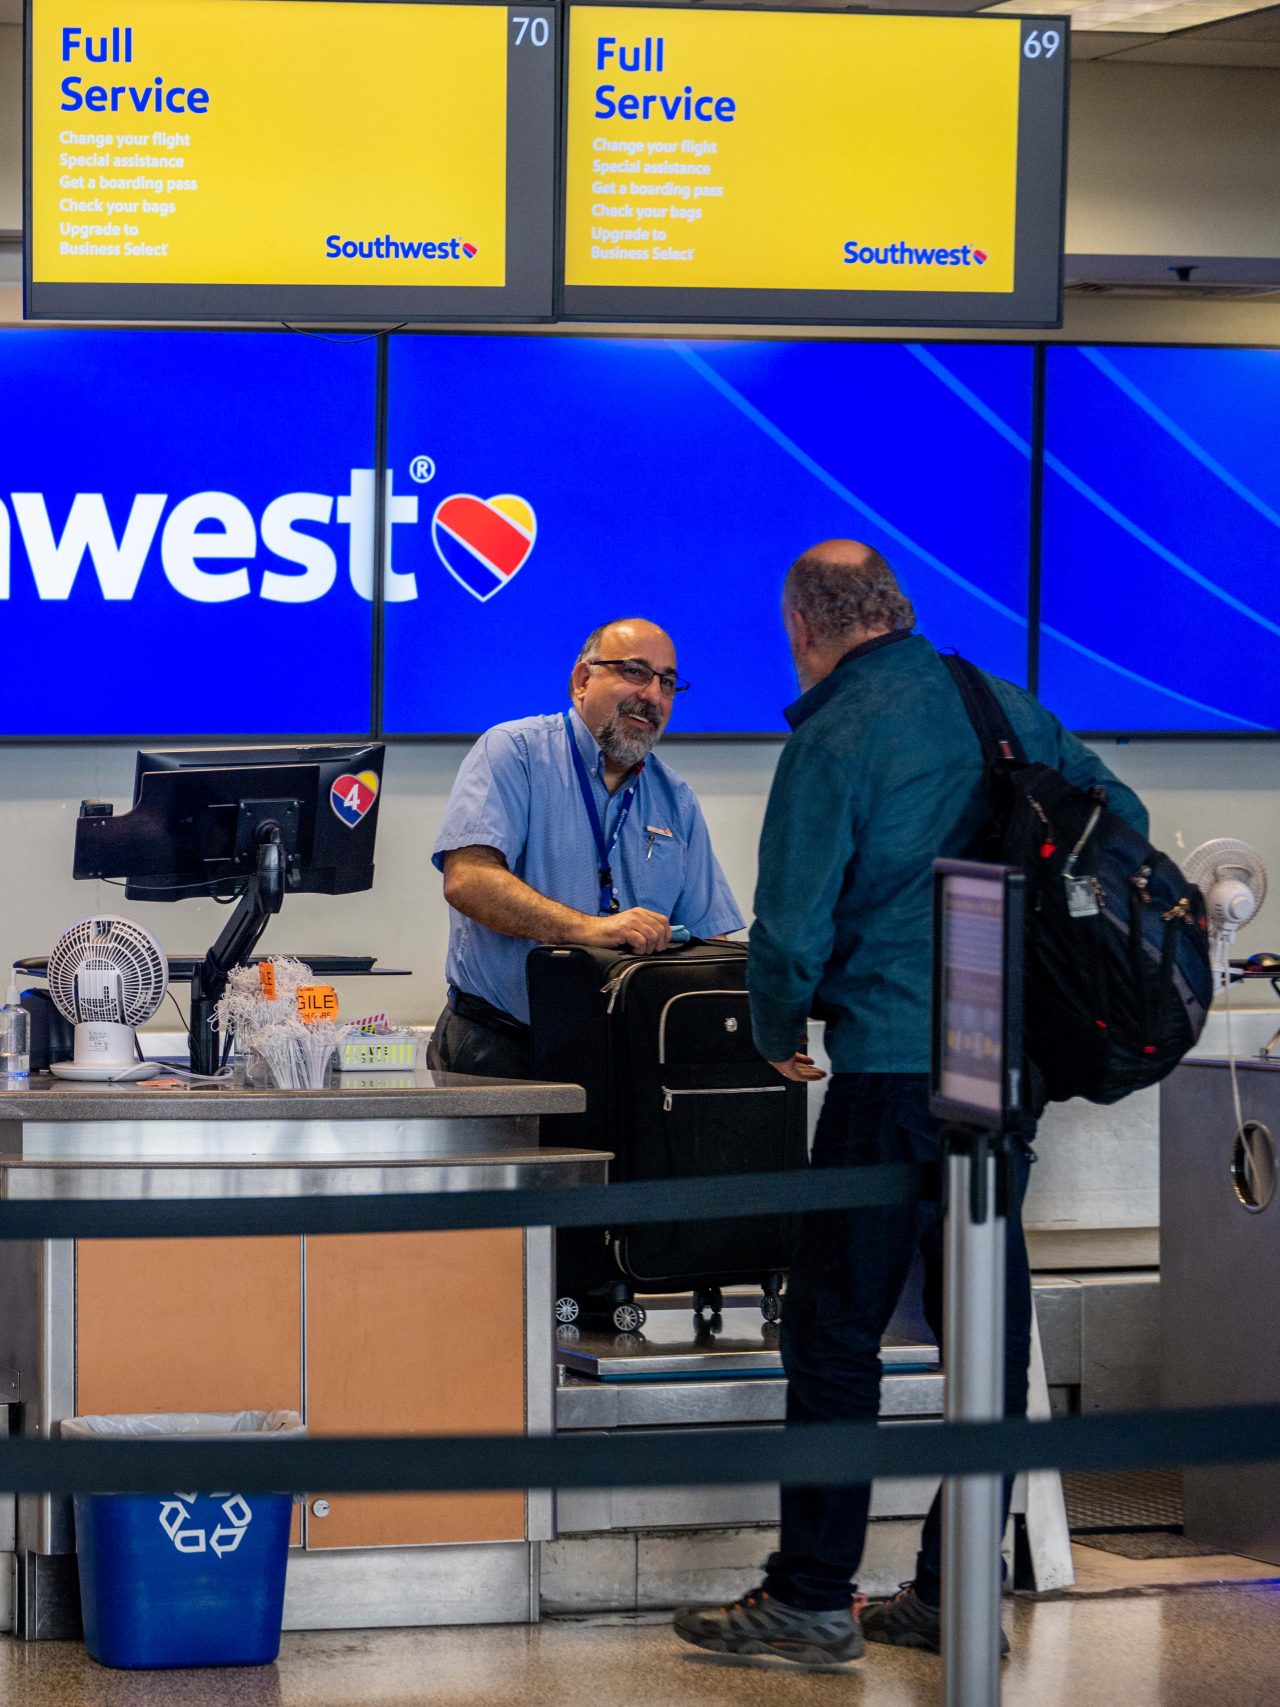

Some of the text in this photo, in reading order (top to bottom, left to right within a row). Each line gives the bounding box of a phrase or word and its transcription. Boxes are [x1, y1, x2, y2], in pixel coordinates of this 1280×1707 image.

[512, 17, 549, 47] 70
[62, 27, 132, 62] Full
[1023, 30, 1060, 60] 69
[597, 37, 663, 72] Full
[61, 76, 209, 113] Service
[595, 85, 736, 122] Service
[59, 131, 190, 149] Change your flight
[593, 138, 717, 156] Change your flight
[60, 153, 184, 169] Special assistance
[593, 160, 711, 175] Special assistance
[59, 175, 198, 193] Get a boarding pass
[592, 181, 723, 199] Get a boarding pass
[59, 198, 175, 216] Check your bags
[592, 204, 702, 222] Check your bags
[60, 222, 138, 239] Upgrade to
[592, 227, 666, 243] Upgrade to
[60, 242, 120, 255] Business
[326, 235, 460, 259] Southwest
[592, 246, 648, 259] Business
[844, 241, 970, 266] Southwest
[343, 783, 360, 811] 4
